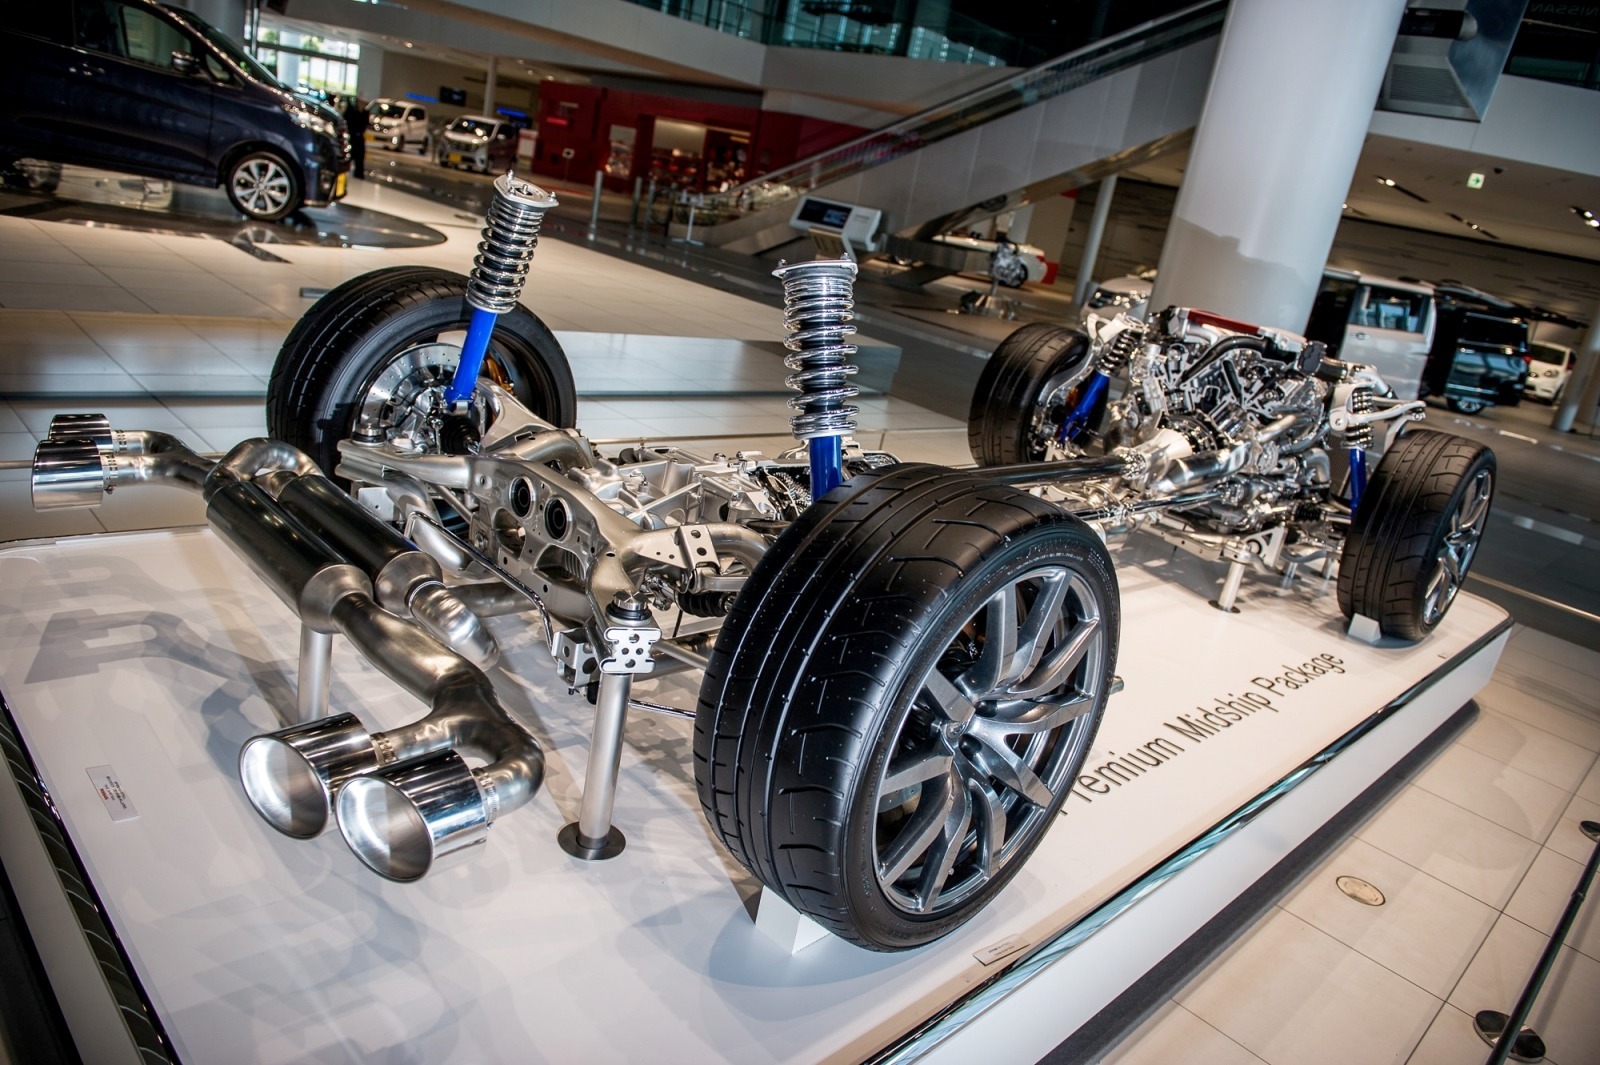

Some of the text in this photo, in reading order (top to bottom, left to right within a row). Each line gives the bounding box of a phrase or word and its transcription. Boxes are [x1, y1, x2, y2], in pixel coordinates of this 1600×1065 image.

[1060, 652, 1346, 815] emium Midship Package
